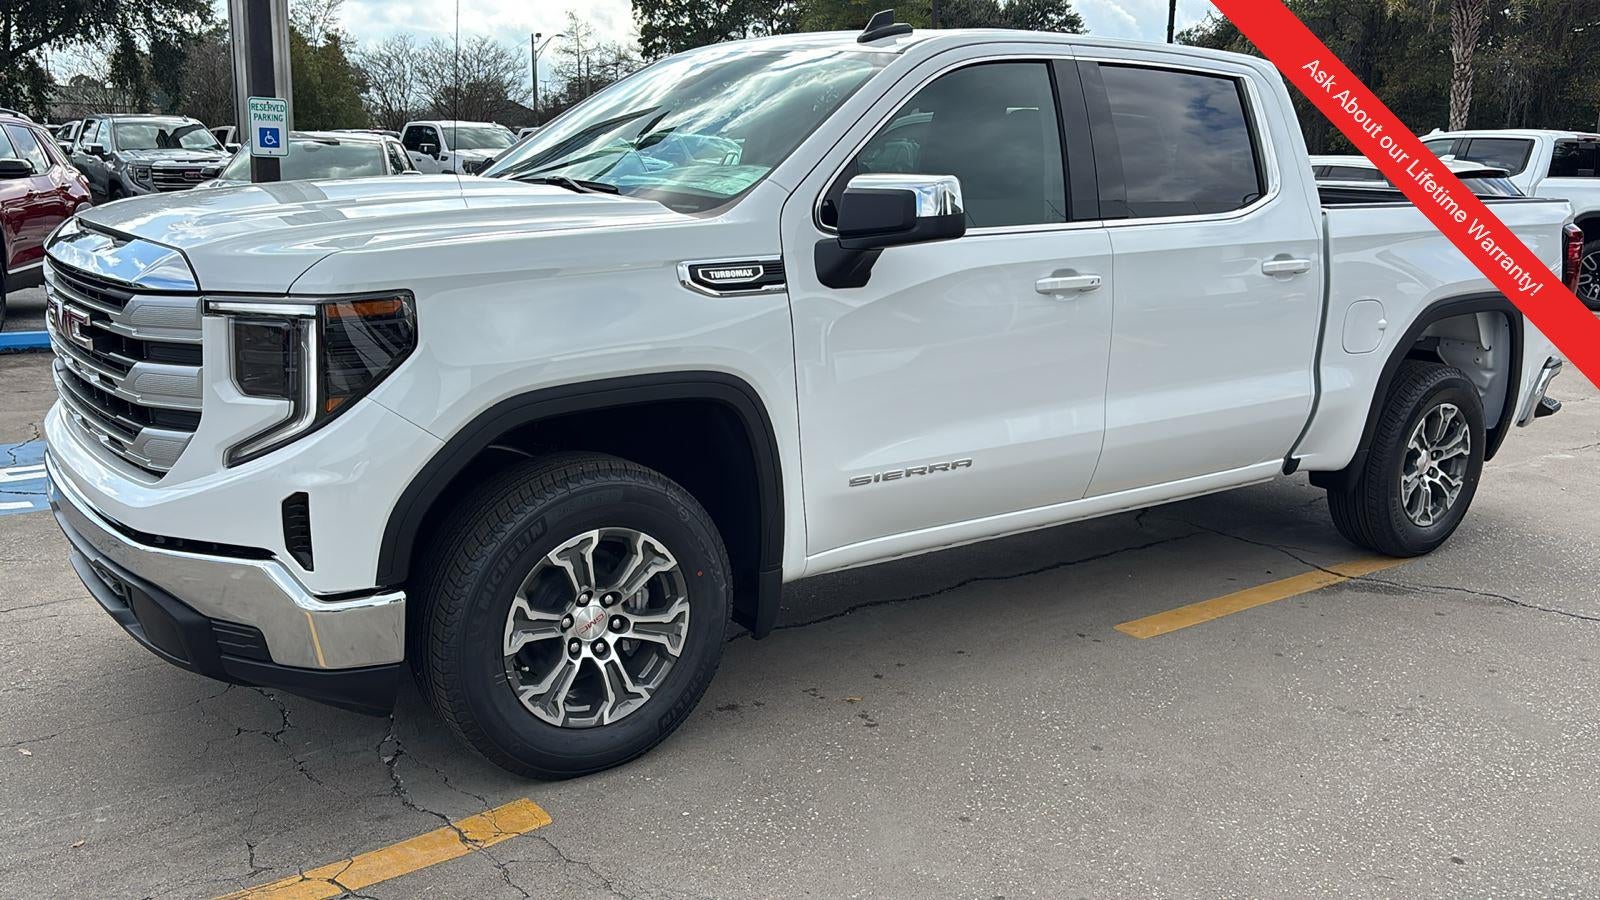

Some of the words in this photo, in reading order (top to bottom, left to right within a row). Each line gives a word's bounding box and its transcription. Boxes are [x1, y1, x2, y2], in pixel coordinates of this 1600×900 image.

[250, 103, 285, 112] RESERVED
[253, 113, 284, 122] PARKING
[709, 268, 754, 279] TURBOMAX
[849, 457, 973, 488] SIERRA
[479, 515, 547, 610] MICHELIN
[577, 613, 604, 634] GMC
